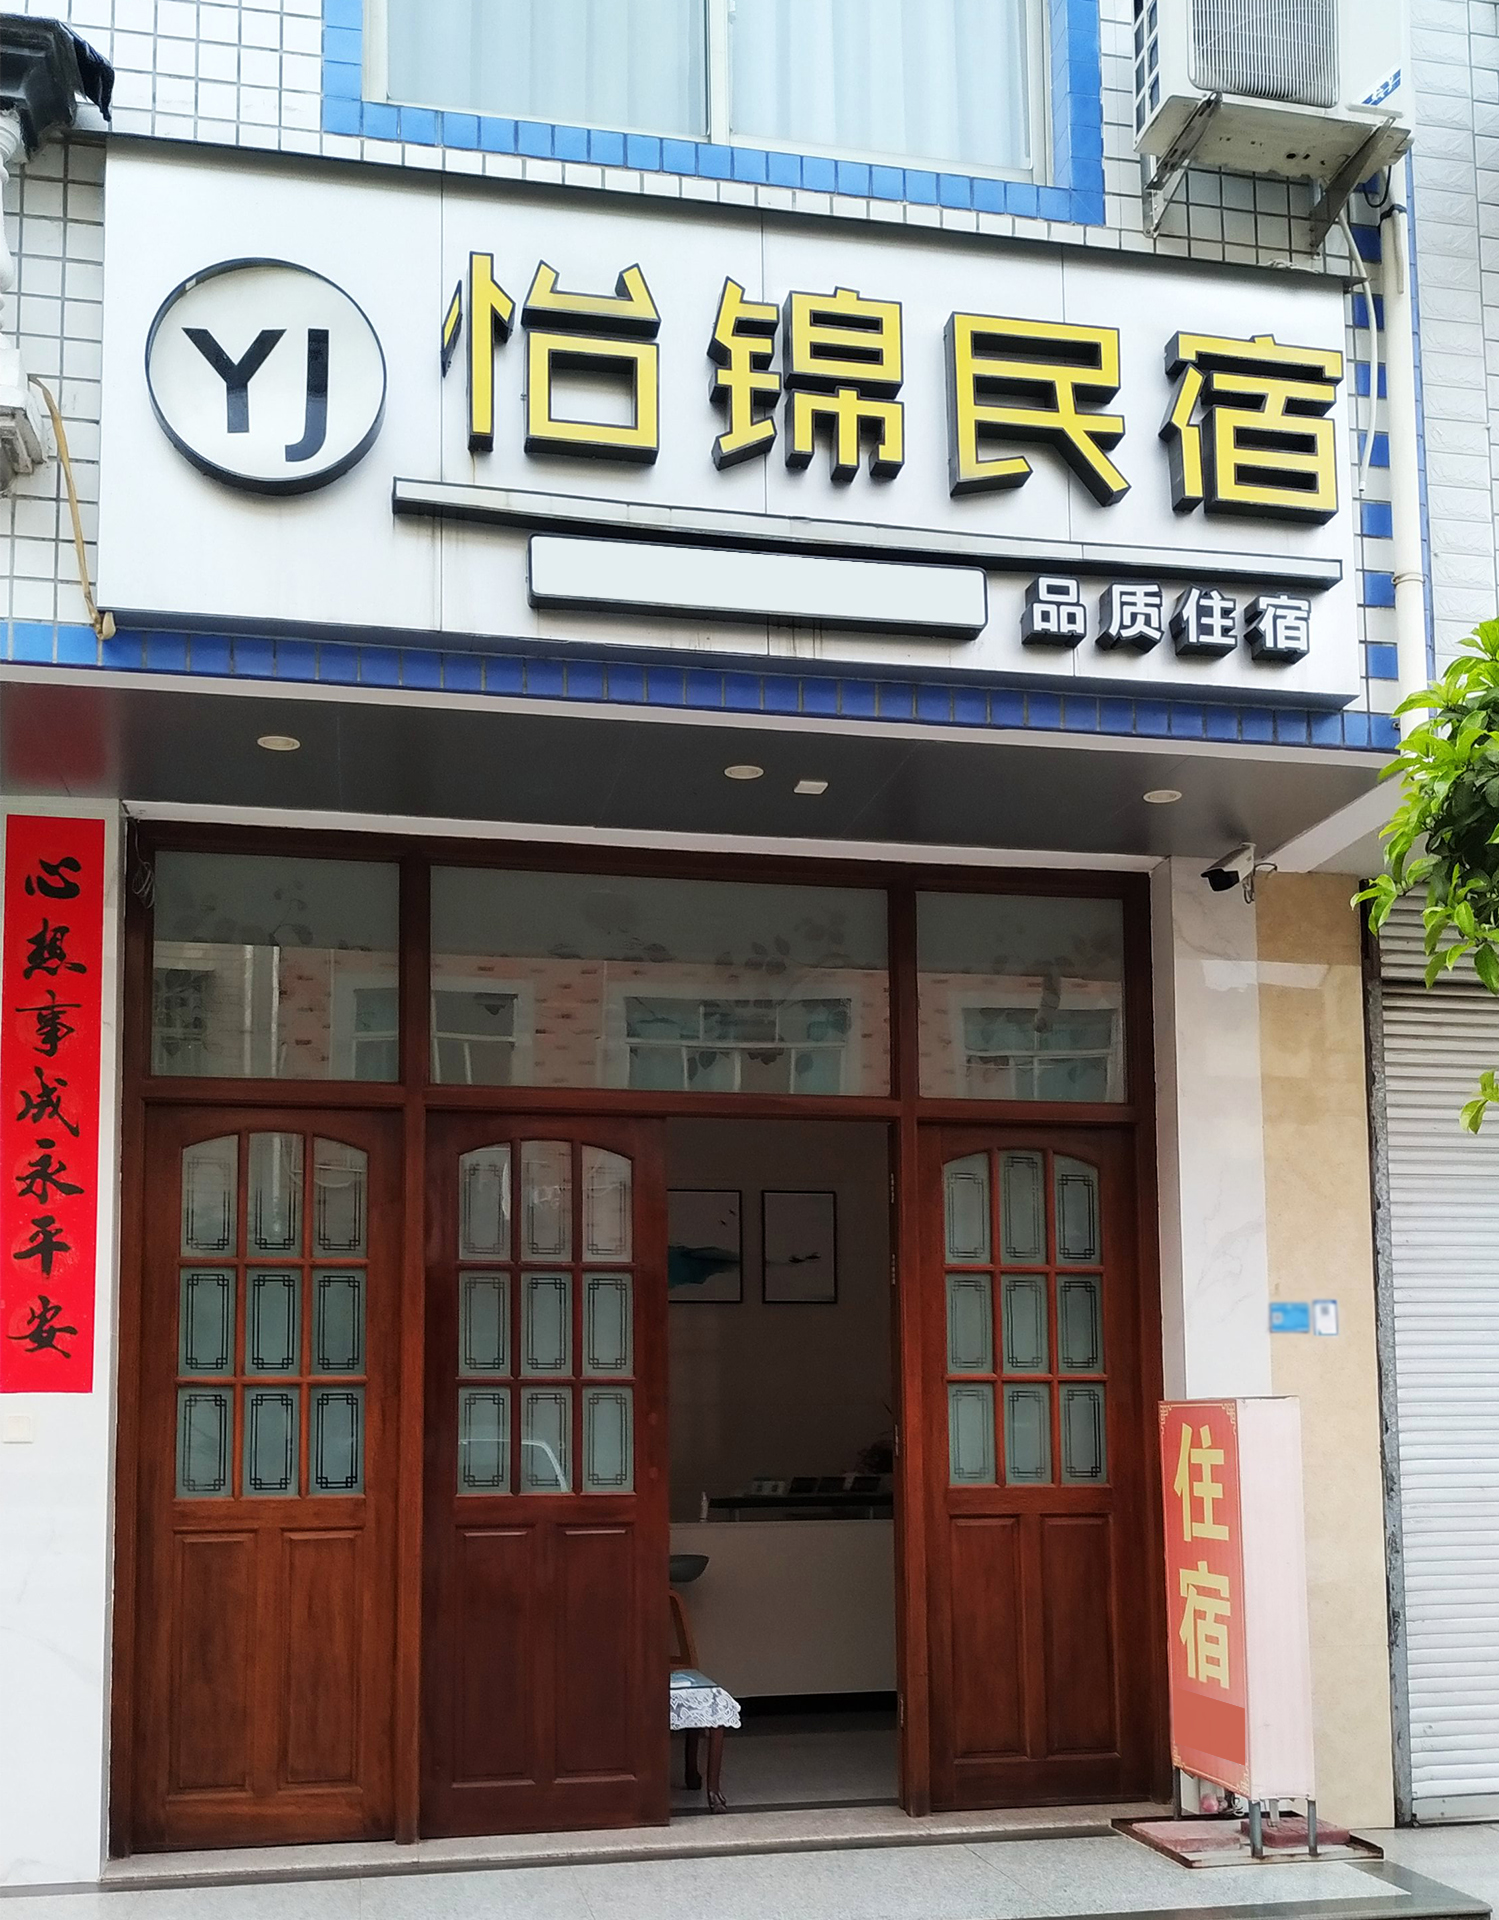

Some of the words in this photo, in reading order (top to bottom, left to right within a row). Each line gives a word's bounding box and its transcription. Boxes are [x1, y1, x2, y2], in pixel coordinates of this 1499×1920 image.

[181, 327, 330, 462] YJ
[441, 251, 1344, 525] 怡锦民宿
[1024, 574, 1312, 660] 品质住宿
[7, 855, 88, 1359] 心想事成永平安
[1172, 1421, 1231, 1690] 住宿
